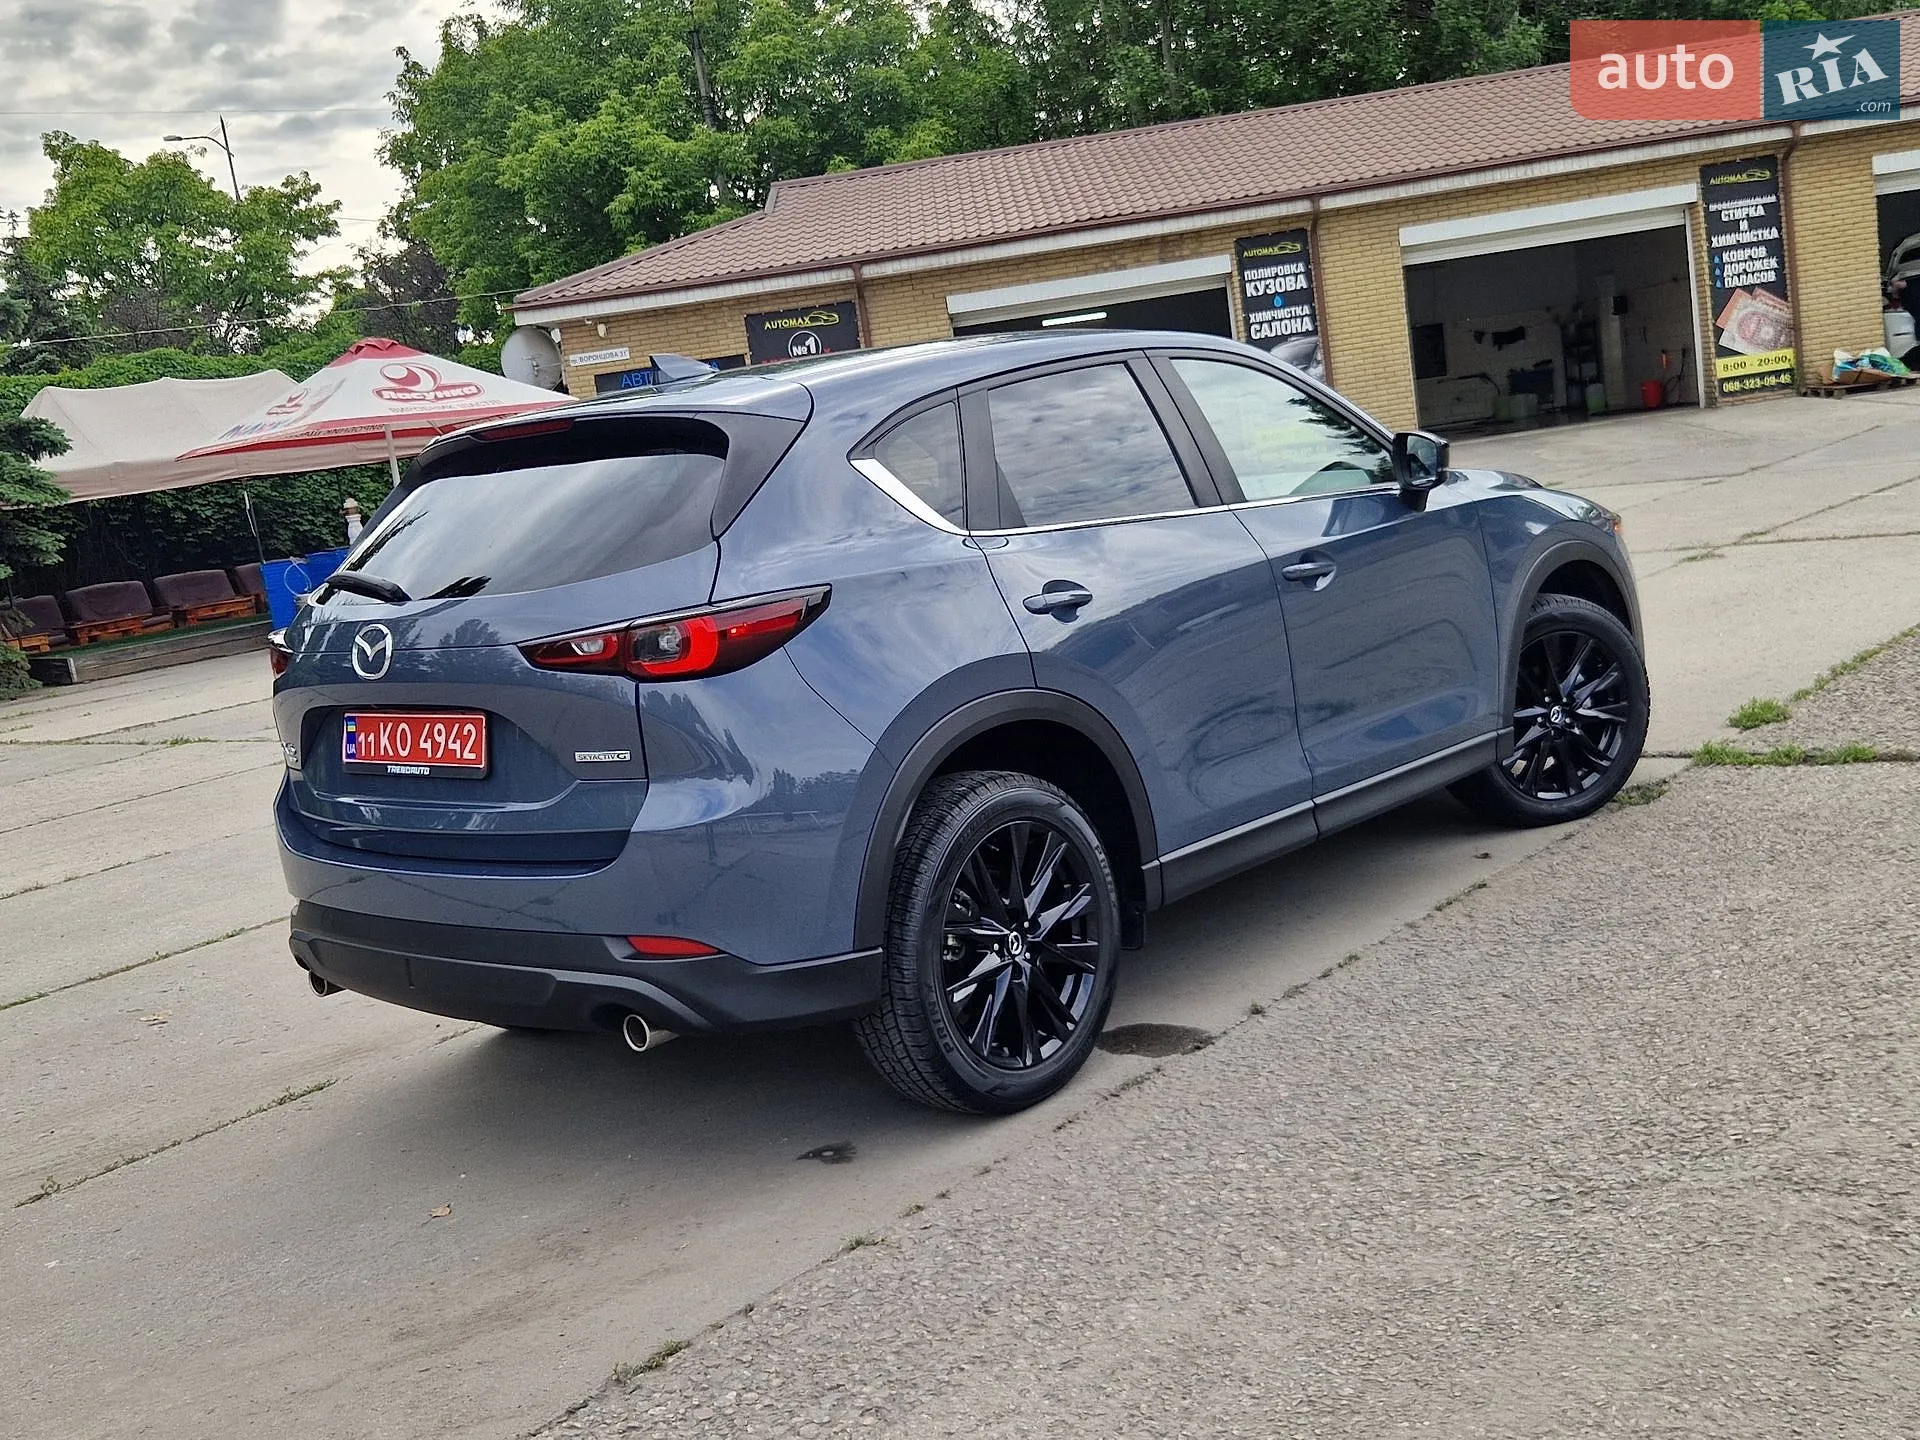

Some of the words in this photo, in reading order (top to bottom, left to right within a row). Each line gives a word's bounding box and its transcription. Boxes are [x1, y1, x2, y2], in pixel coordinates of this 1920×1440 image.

[1721, 204, 1766, 222] СТИРКА
[1739, 219, 1749, 231] И
[1711, 226, 1780, 248] ХИМЧИСТКА
[1243, 246, 1279, 258] AUTOMAX
[1722, 245, 1768, 263] КОВРОВ
[1244, 262, 1305, 281] ПОЛИРОВКА
[1723, 256, 1779, 278] ДОРОЖЕК
[1245, 273, 1308, 298] КУЗОВА
[1724, 269, 1777, 289] ПАЛАСОВ
[764, 316, 811, 331] AUTOMAX
[1249, 304, 1311, 324] ХИМЧИСТКА
[1250, 316, 1314, 340] САЛОНА
[1722, 361, 1747, 373] 8:00
[347, 743, 356, 754] UA
[419, 722, 477, 760] 4942
